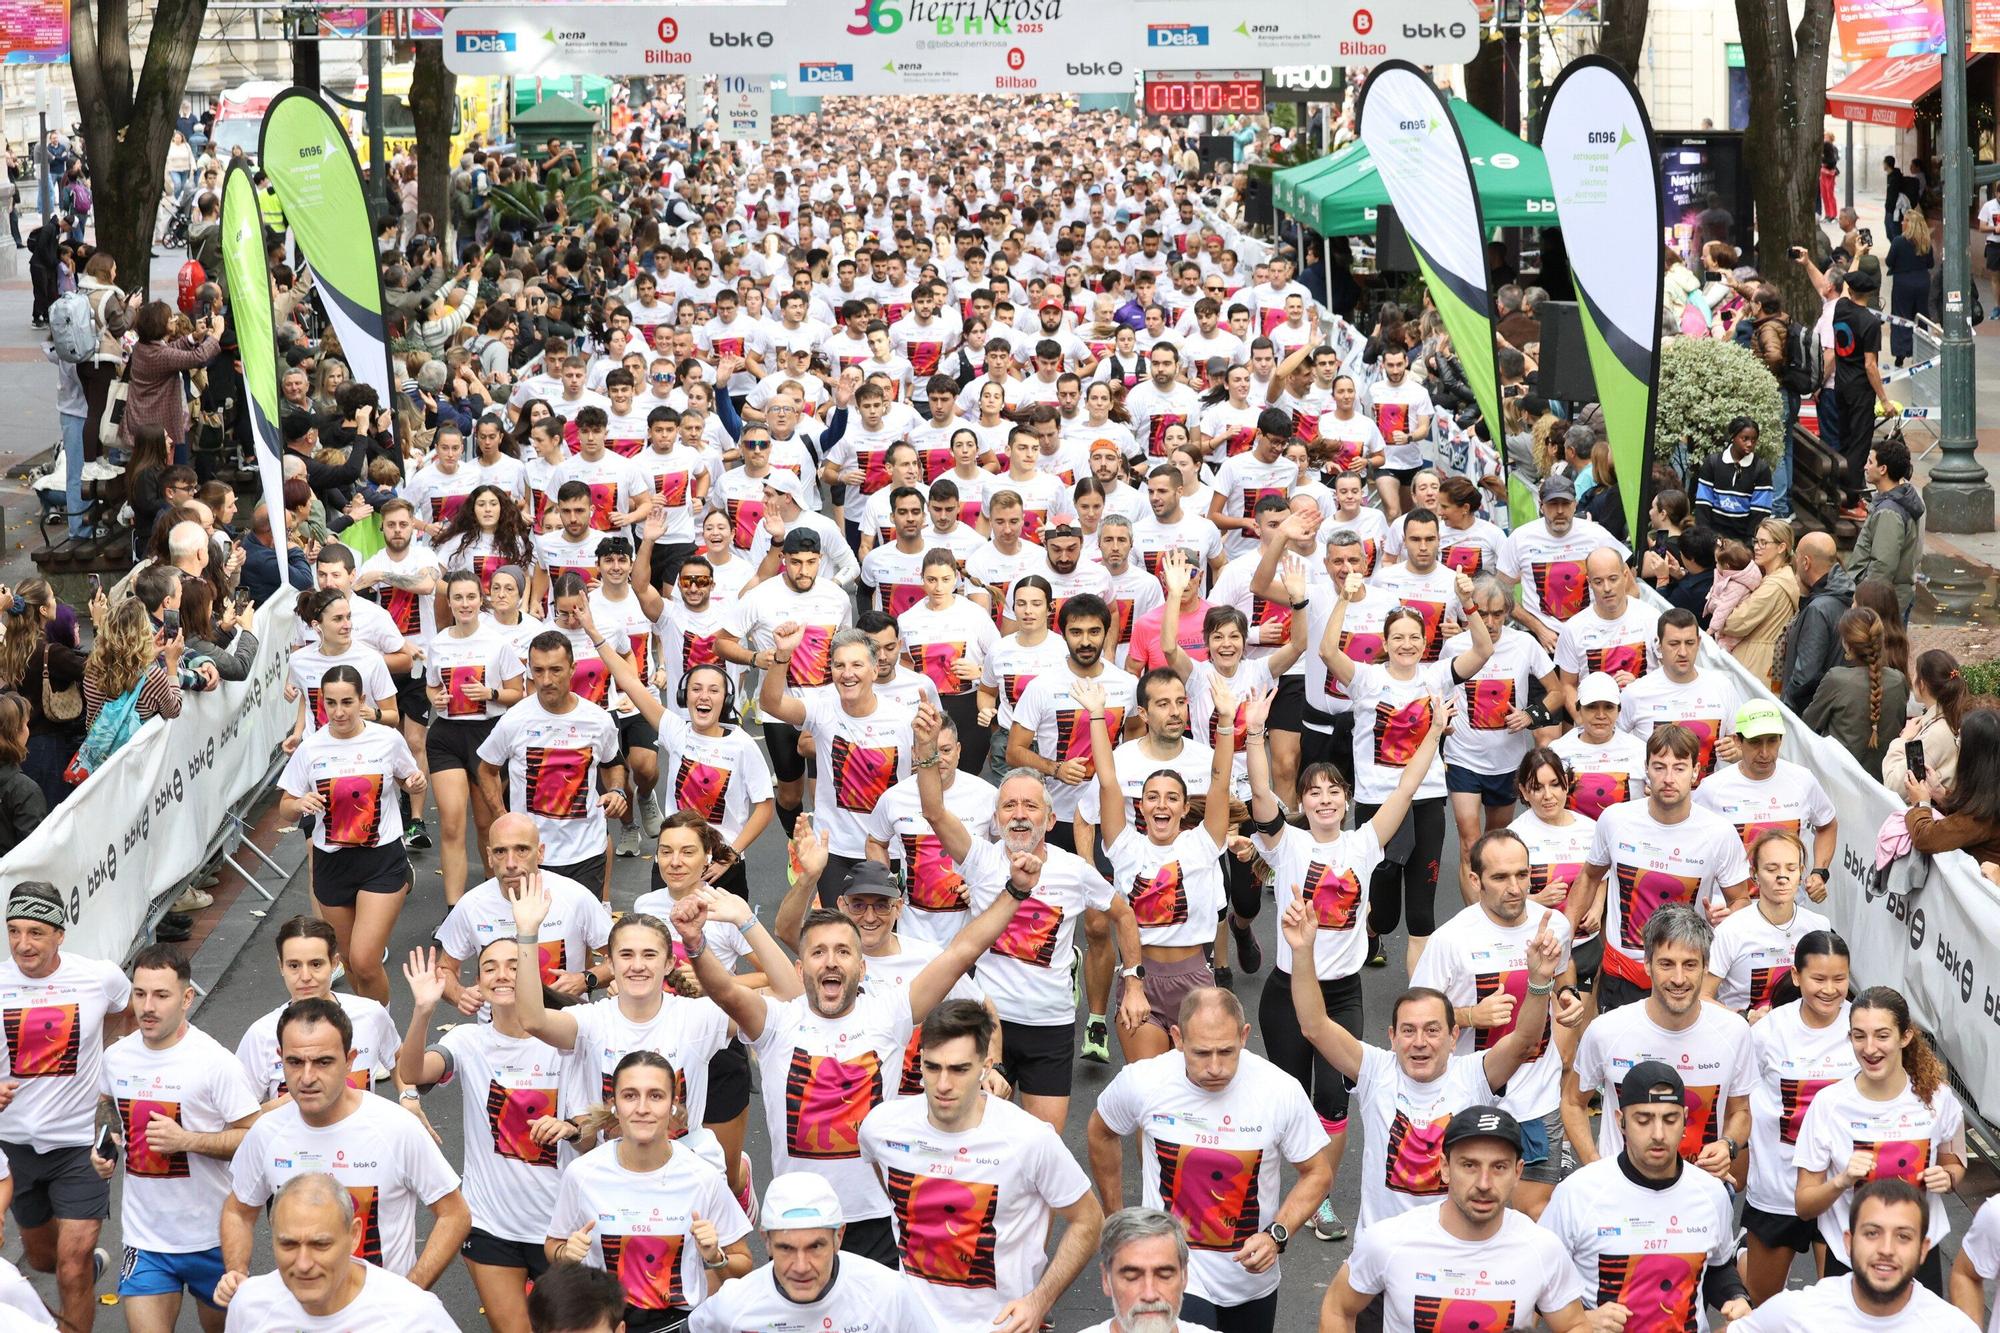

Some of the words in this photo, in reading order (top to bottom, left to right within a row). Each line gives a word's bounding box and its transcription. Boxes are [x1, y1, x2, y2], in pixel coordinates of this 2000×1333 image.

[558, 30, 586, 40] aena
[1017, 23, 1044, 33] 2025
[1251, 24, 1279, 33] aena
[1402, 23, 1446, 39] bbk
[465, 36, 507, 52] Deia
[709, 32, 754, 48] bbk
[1156, 29, 1199, 46] Deia
[1340, 41, 1387, 56] Bilbao
[645, 50, 692, 64] Bilbao
[898, 62, 922, 71] aena
[1066, 62, 1106, 76] bbk
[808, 67, 845, 82] Deia
[724, 76, 745, 93] 10
[995, 76, 1037, 89] Bilbao
[1153, 84, 1260, 111] 00:00:26
[188, 749, 206, 781] bbk
[155, 782, 173, 816] bbk
[125, 819, 142, 856] bbk
[1650, 860, 1669, 871] 8901
[1843, 843, 1866, 887] bbk
[87, 860, 108, 898] bbk
[1936, 933, 1961, 982] bbk
[1239, 1125, 1257, 1133] bbk
[1195, 1134, 1220, 1145] 7938
[631, 1224, 652, 1233] 6526
[1643, 1240, 1667, 1250] 2677
[1454, 1287, 1476, 1296] 6237
